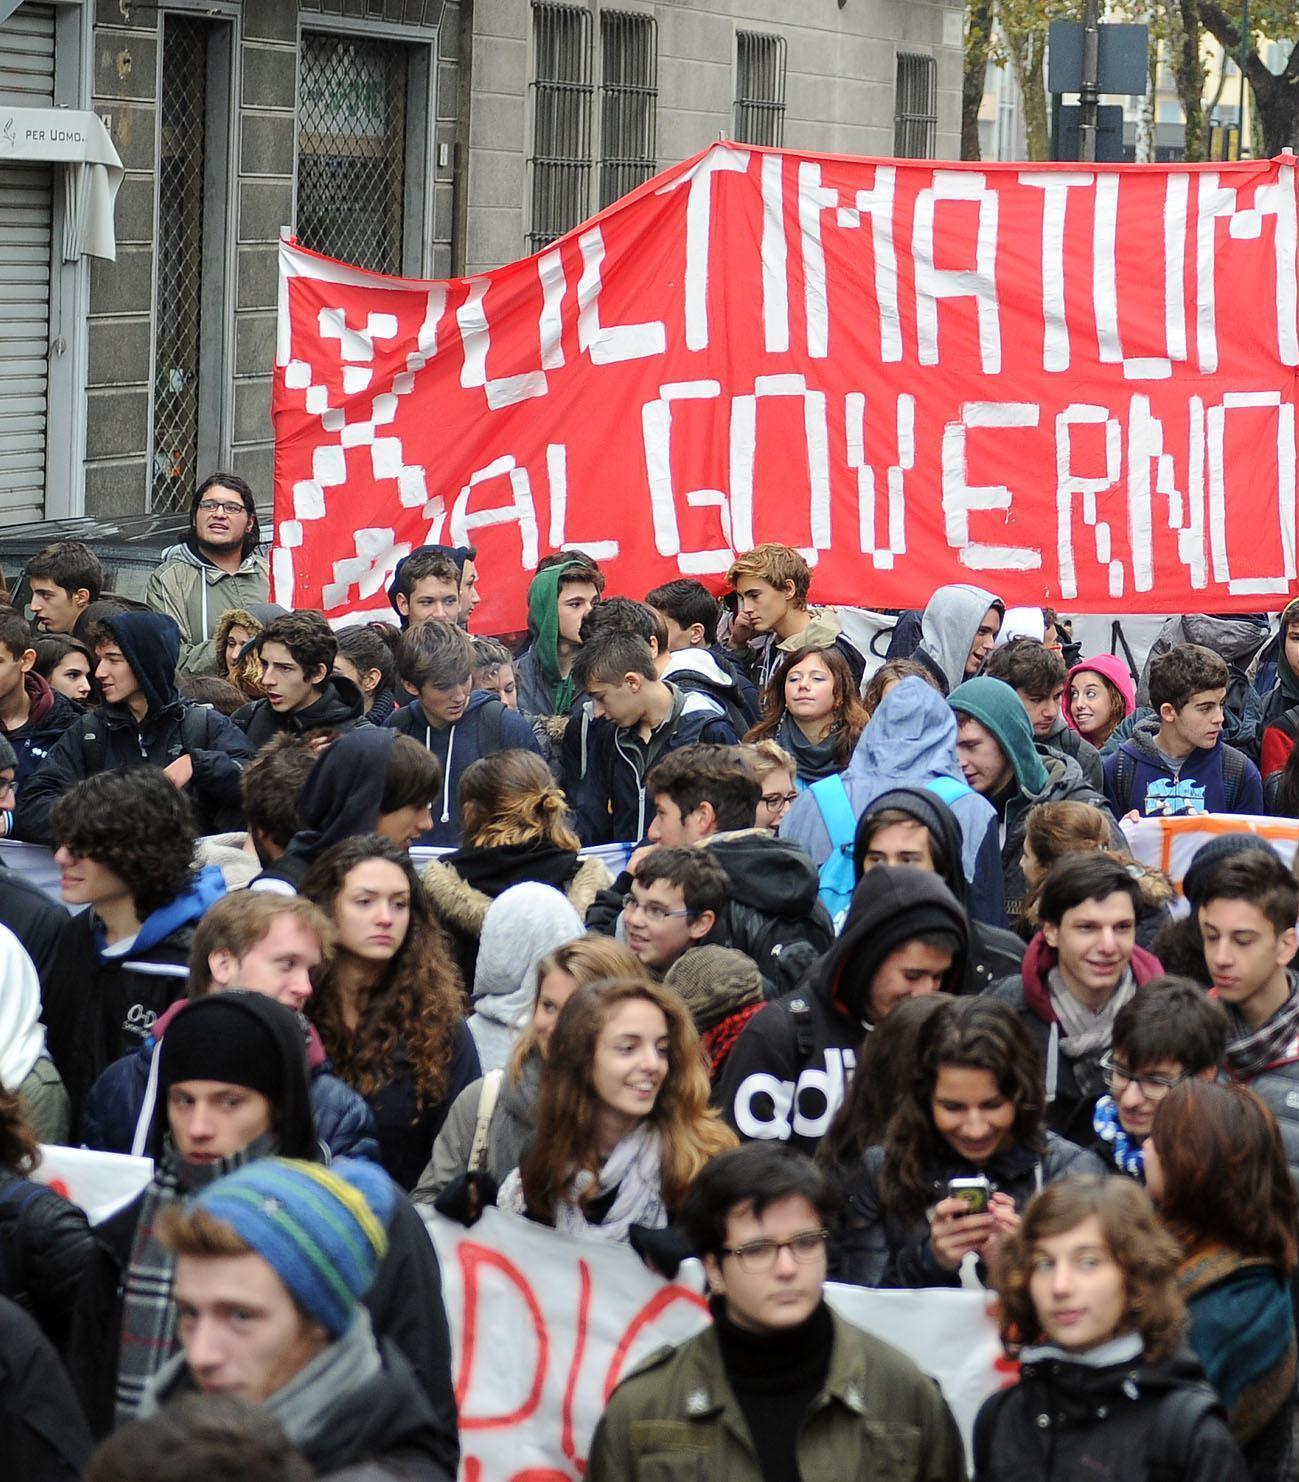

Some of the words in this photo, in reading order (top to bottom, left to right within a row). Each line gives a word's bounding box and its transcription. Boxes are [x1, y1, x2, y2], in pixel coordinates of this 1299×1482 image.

[26, 129, 45, 141] PER
[456, 146, 1299, 411] ULTIMATUM
[449, 443, 619, 571] AL
[641, 373, 1297, 599] GOVERNO
